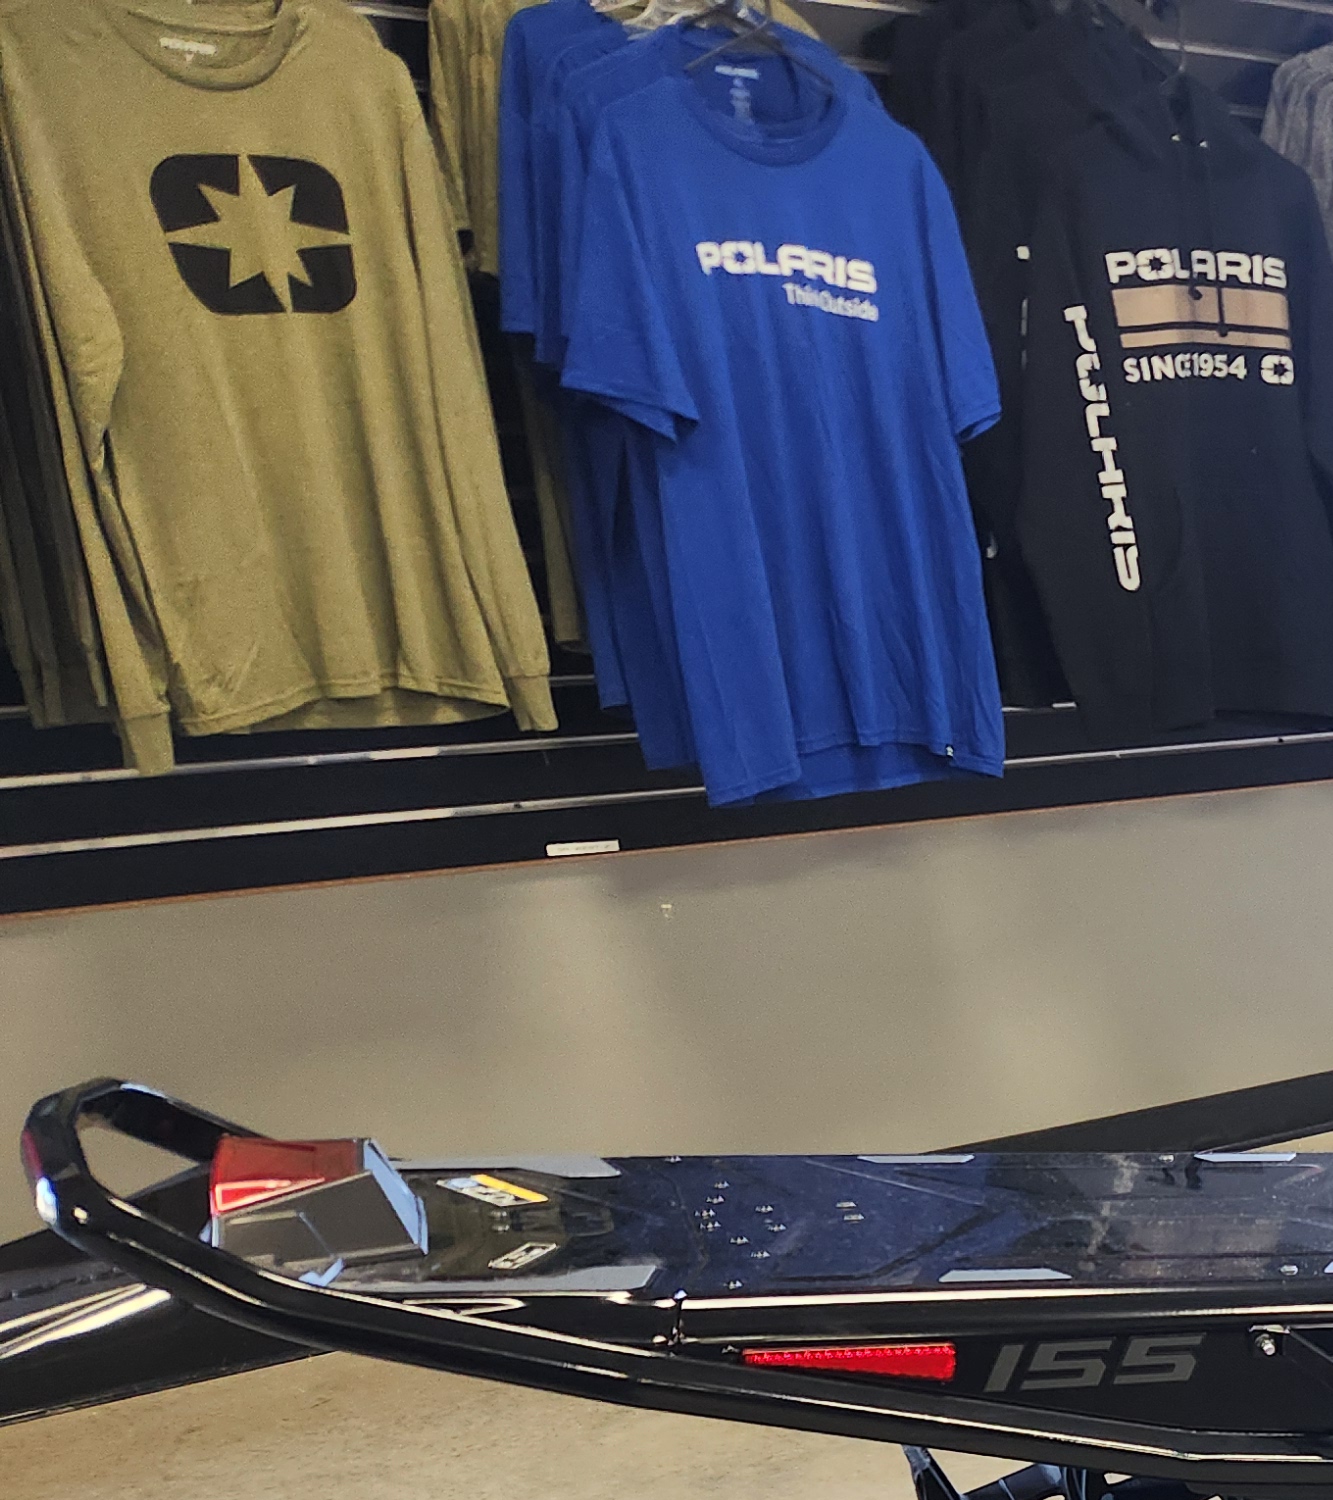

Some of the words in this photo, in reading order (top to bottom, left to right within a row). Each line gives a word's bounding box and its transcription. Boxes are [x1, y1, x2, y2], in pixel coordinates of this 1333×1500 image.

[695, 240, 878, 294] POLARIS
[1105, 247, 1288, 289] POLARIS
[1191, 352, 1248, 380] 1954
[983, 1332, 1207, 1393] 155
